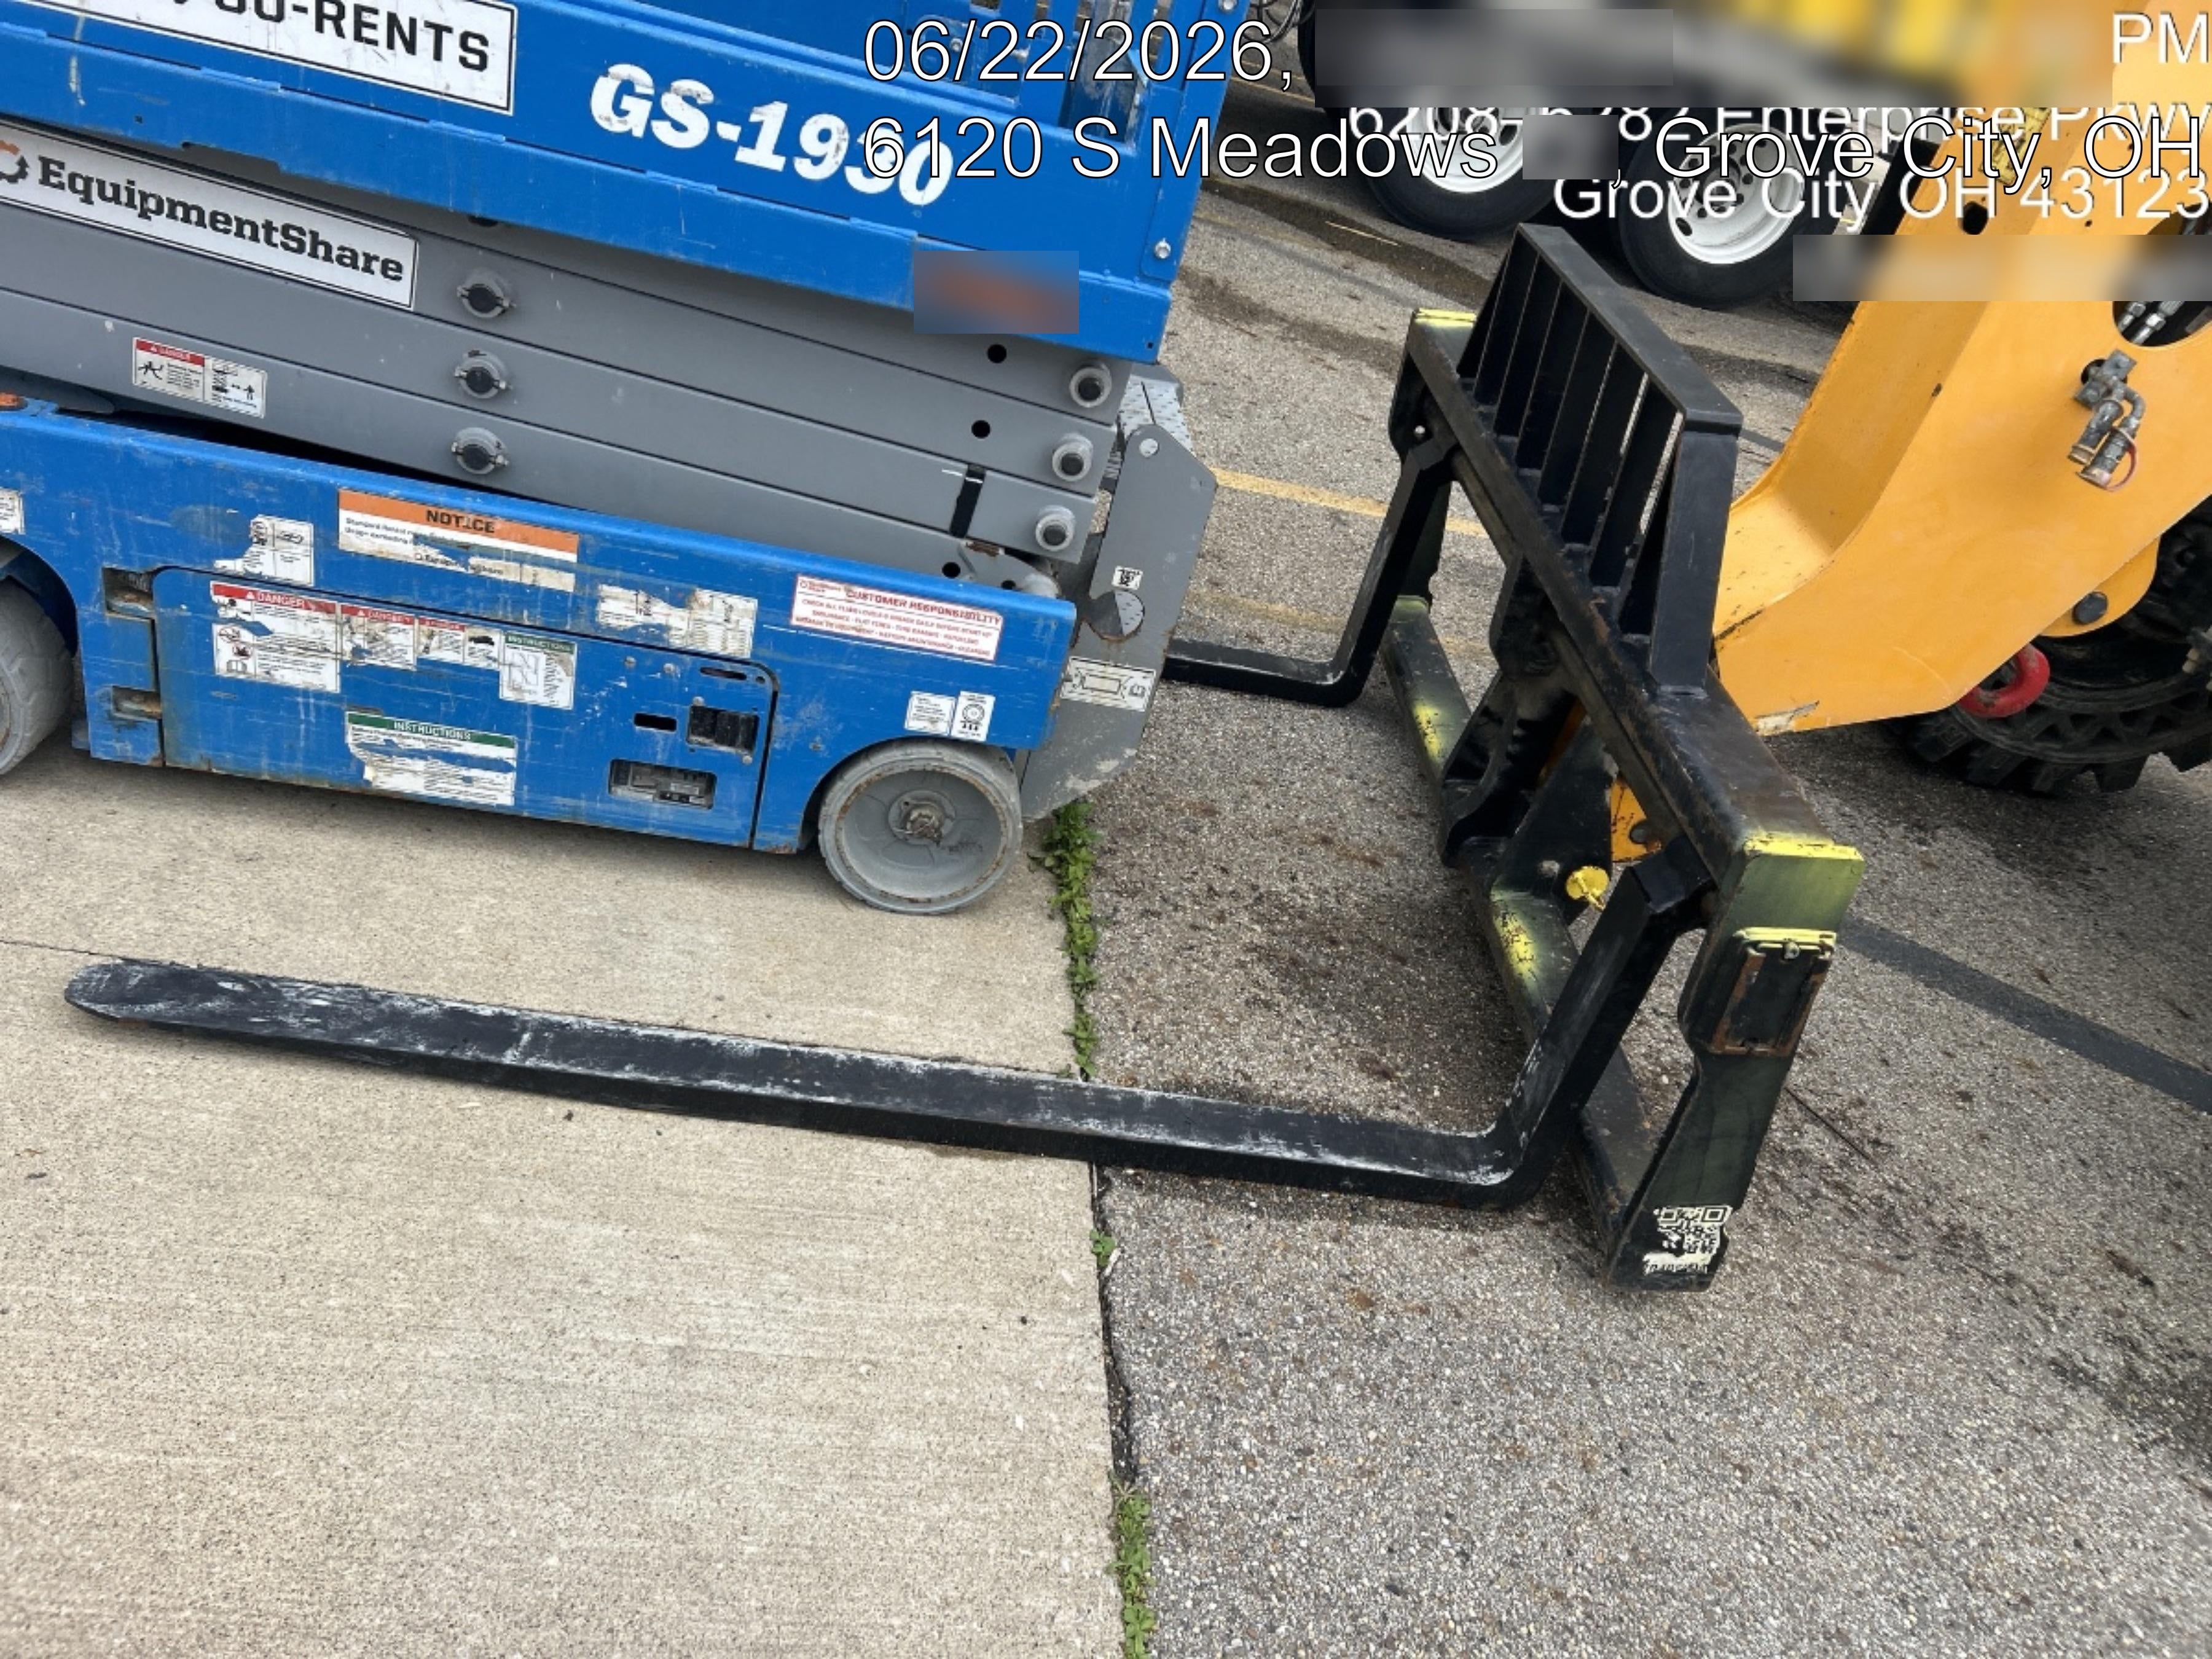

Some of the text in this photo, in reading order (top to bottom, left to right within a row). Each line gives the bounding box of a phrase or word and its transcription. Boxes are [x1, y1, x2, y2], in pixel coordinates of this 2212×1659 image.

[590, 63, 954, 206] GS-1930
[37, 155, 404, 282] EquipmentShare
[426, 510, 495, 533] NOTICE
[258, 592, 305, 608] DANGER
[846, 590, 1000, 624] CUSTOMER RESPONSIBILITY
[394, 721, 471, 740] INSTRUCTIONS
